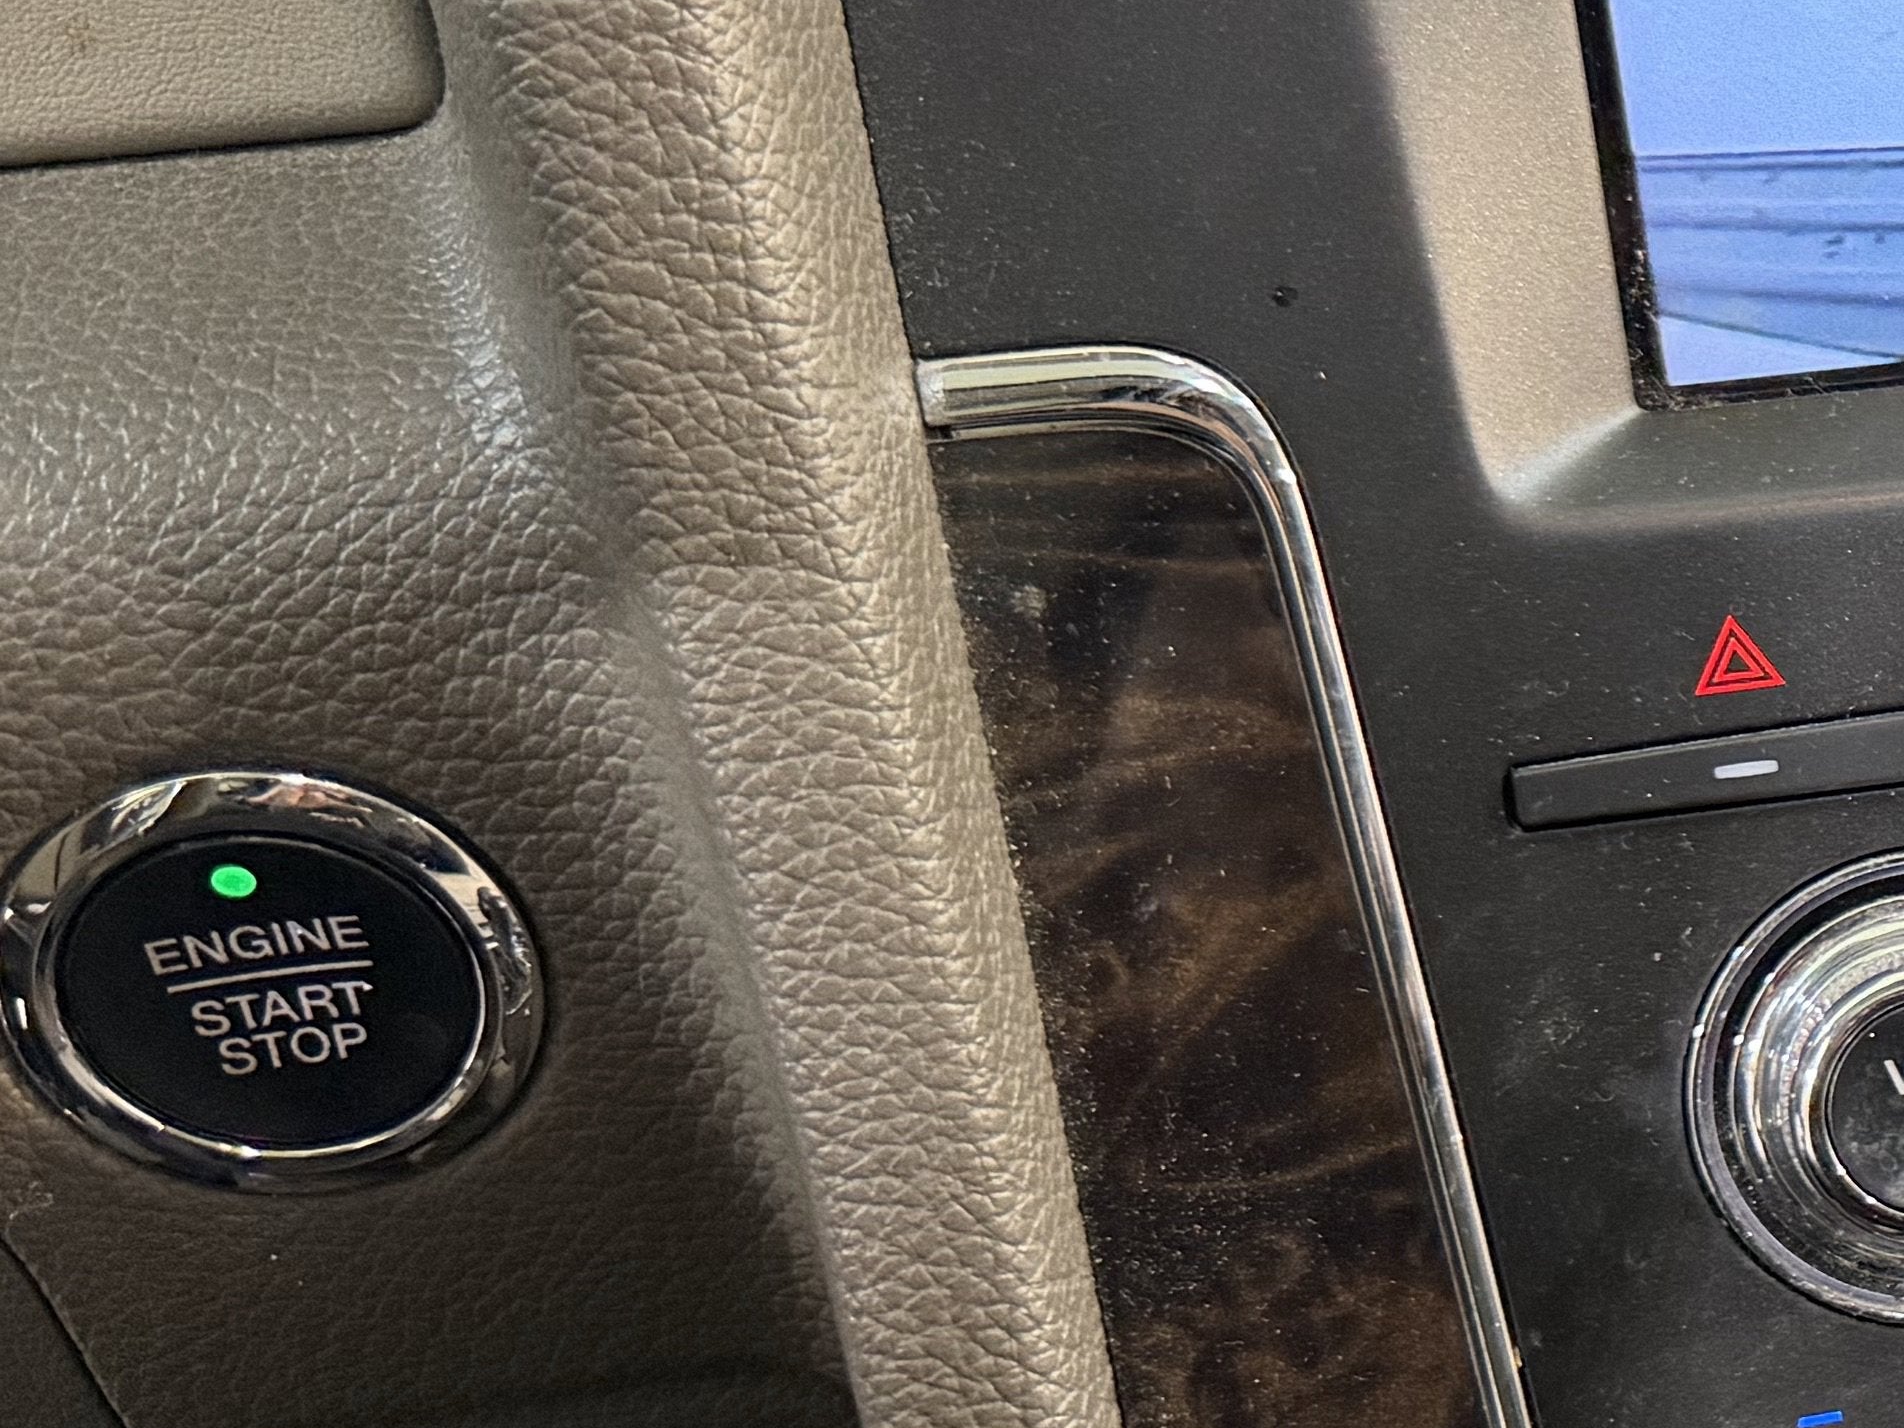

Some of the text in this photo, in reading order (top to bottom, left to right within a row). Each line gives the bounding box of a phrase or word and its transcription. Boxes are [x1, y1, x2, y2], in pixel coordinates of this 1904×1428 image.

[143, 914, 370, 976] ENGINE
[190, 980, 374, 1037] START
[218, 1022, 368, 1076] STOP
